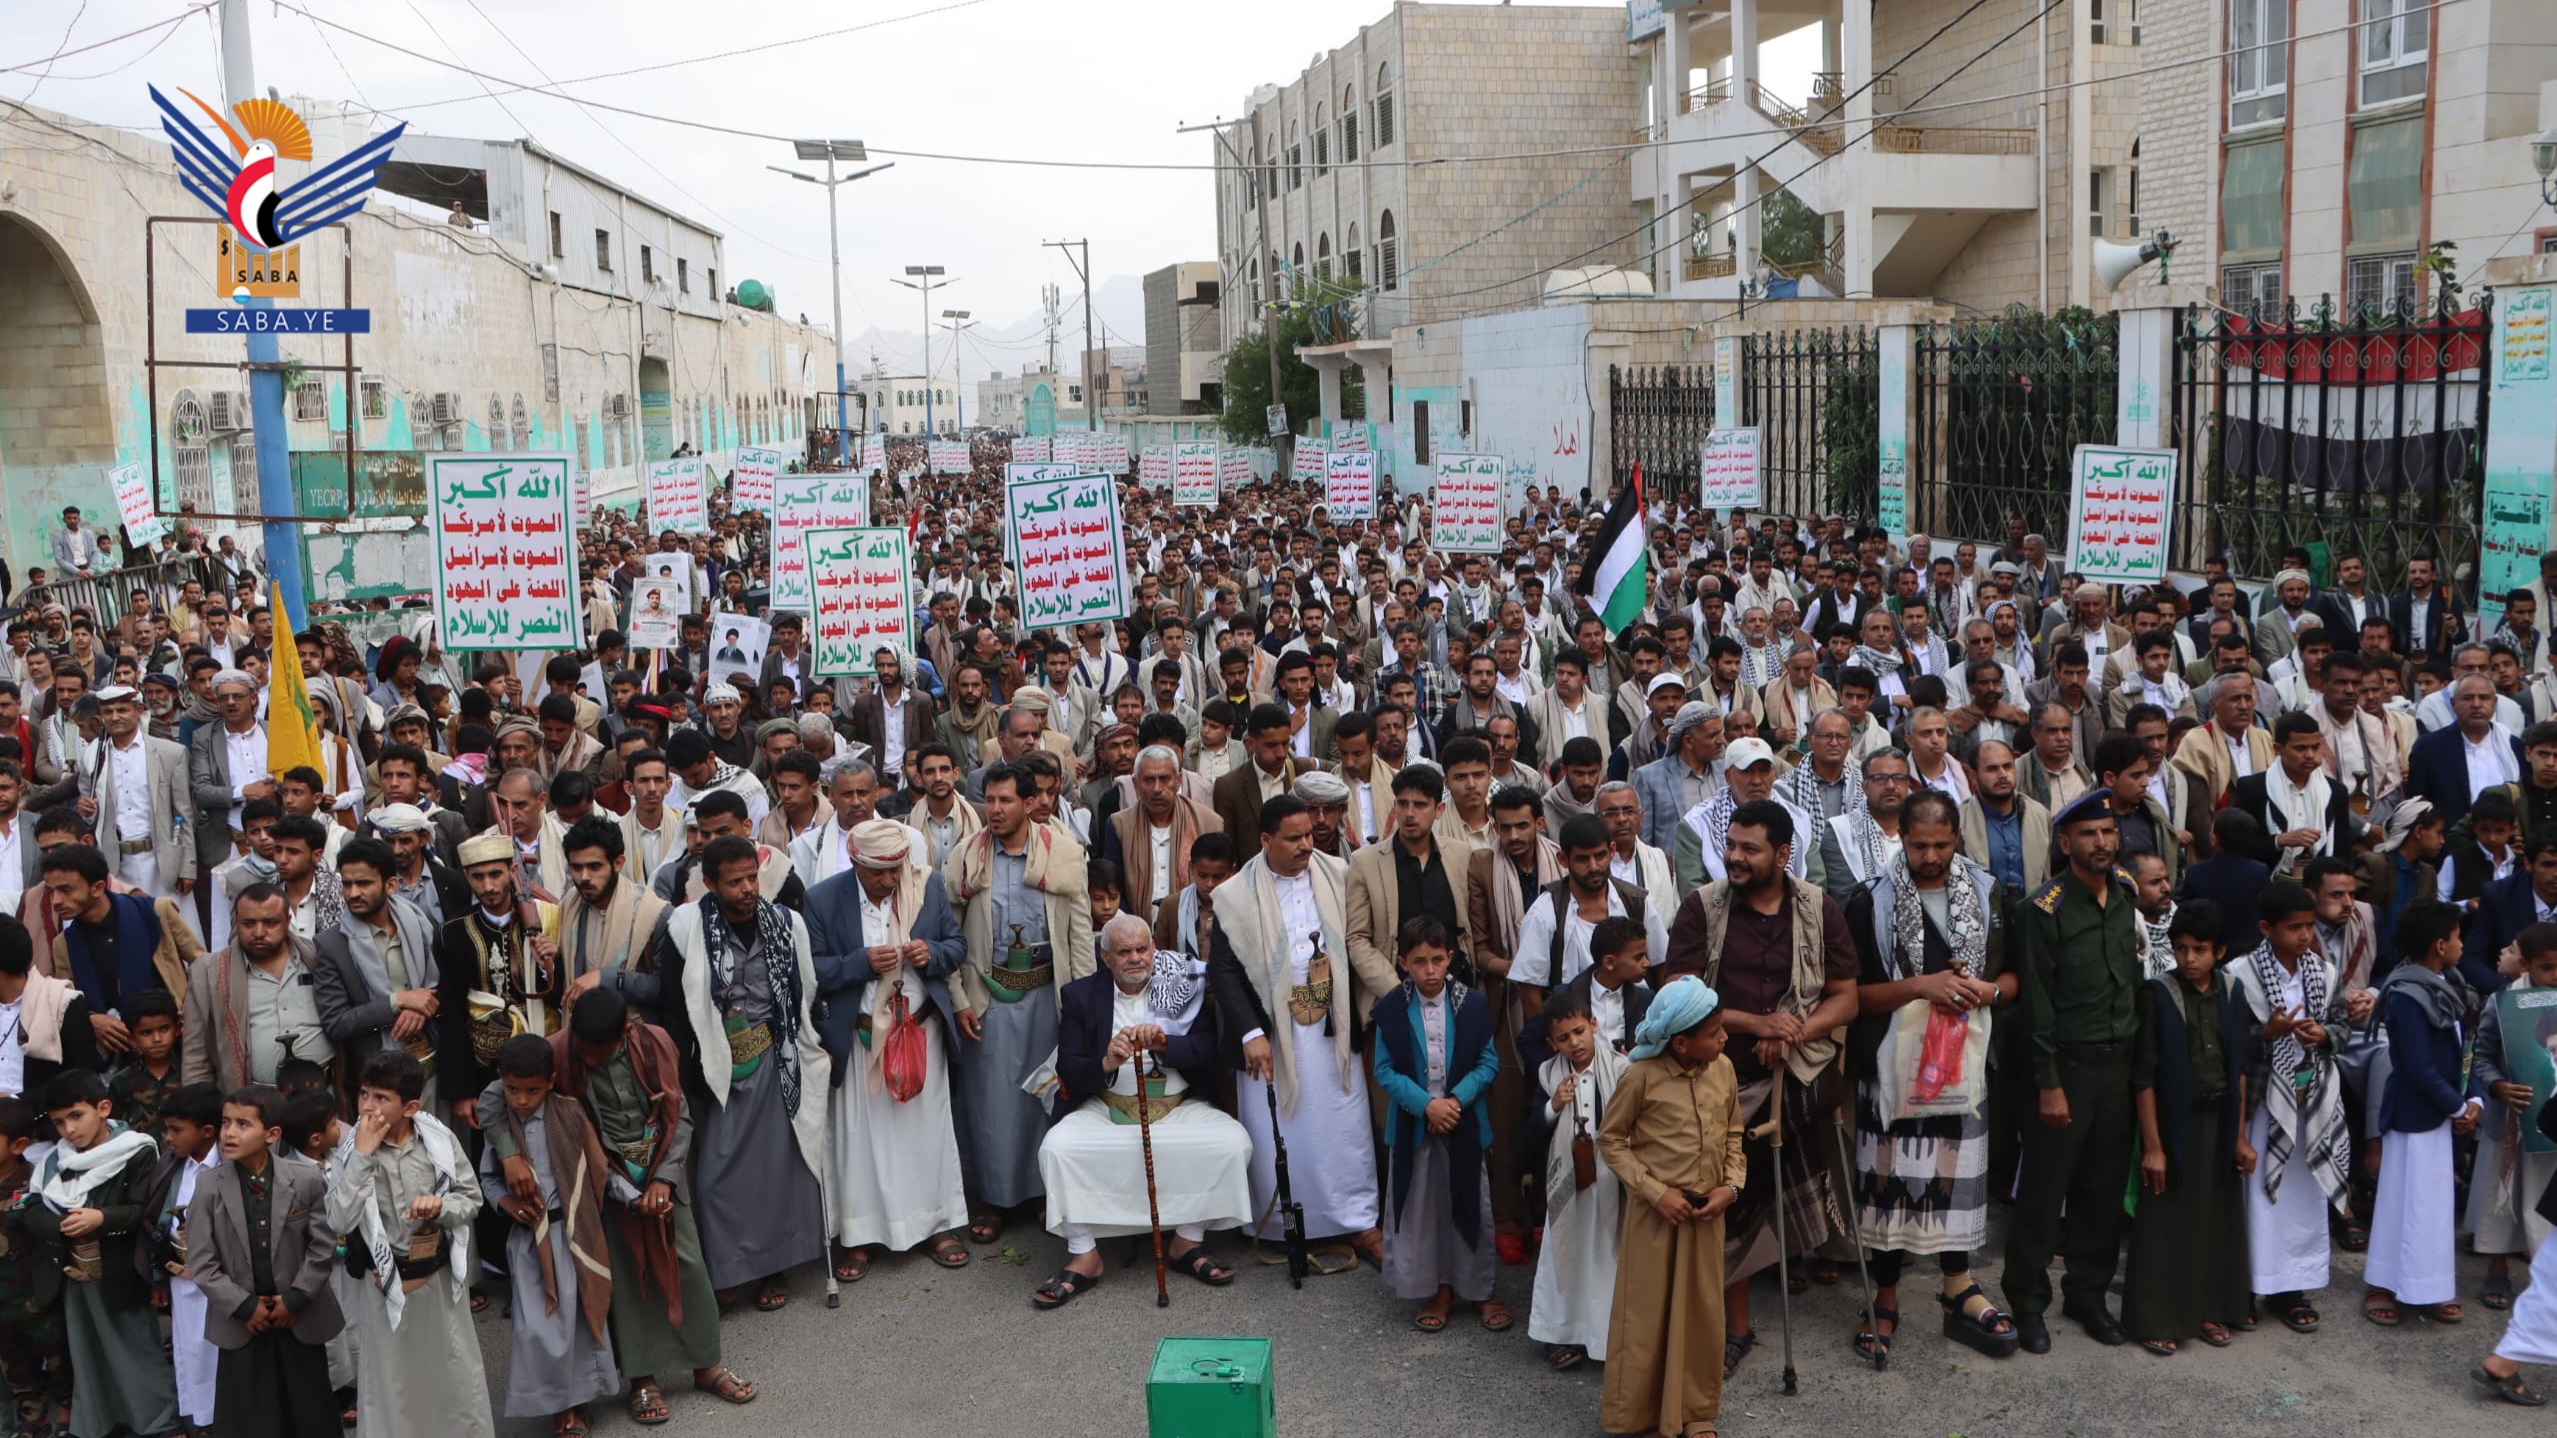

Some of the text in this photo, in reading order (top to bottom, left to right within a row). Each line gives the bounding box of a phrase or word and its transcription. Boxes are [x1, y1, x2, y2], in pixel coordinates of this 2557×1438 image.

[1478, 459, 1501, 474] الله
[2087, 457, 2167, 485] الله أكبر
[442, 466, 512, 509] أكبر
[517, 470, 560, 498] الله
[830, 483, 861, 502] الله
[1473, 481, 1499, 493] الموت
[2085, 481, 2164, 504] الموت لأمريكا
[310, 489, 342, 507] YECRP
[1018, 485, 1106, 520] الله أكبر
[1472, 498, 1499, 510] الموت
[443, 506, 505, 537] لأمريكا
[511, 513, 561, 536] الموت
[825, 512, 859, 528] الموت
[1436, 513, 1498, 526] اللعنة على اليهود
[2083, 507, 2163, 525] الموت لإسرائيل
[1019, 516, 1108, 541] الموت لأمريكا
[1470, 528, 1498, 545] النصر
[2081, 530, 2161, 546] اللعنة على اليهود
[445, 545, 563, 570] الموت لإسرائيل
[815, 534, 898, 567] الله أكبر
[1022, 541, 1110, 568] الموت لإسرائيل
[2080, 549, 2160, 571] النصر للإسلام
[527, 578, 565, 598] اللعنة
[816, 566, 899, 589] الموت لأمريكا
[1025, 566, 1113, 592] اللعنة على اليهود
[447, 579, 490, 602] اليهود
[496, 579, 520, 602] على
[817, 593, 901, 614] الموت لإسرائيل
[1028, 587, 1116, 619] النصر للإسلام
[449, 606, 568, 642] النصر للإسلام
[819, 618, 903, 639] اللعنة على اليهود
[821, 643, 862, 669] للإسلام
